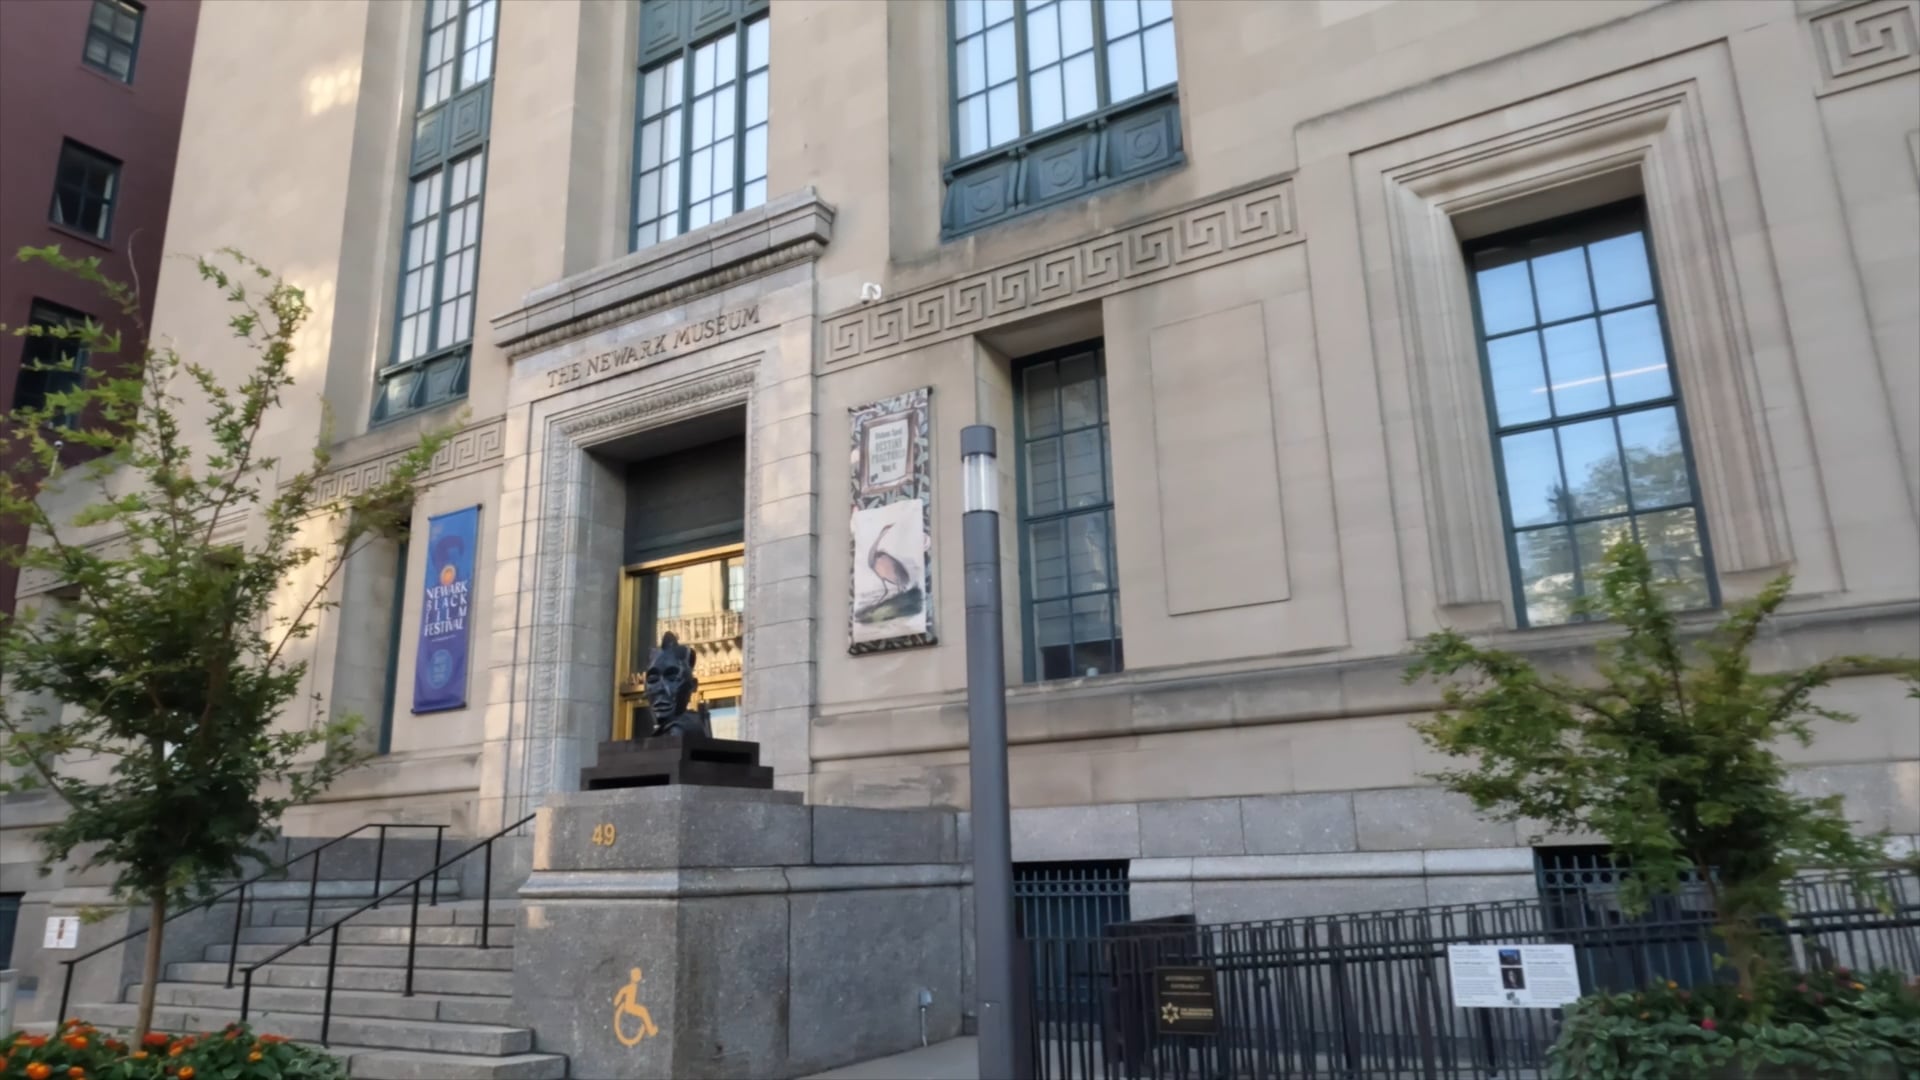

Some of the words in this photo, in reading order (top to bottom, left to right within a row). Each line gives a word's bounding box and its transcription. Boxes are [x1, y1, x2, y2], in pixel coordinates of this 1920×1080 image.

[547, 361, 581, 388] THE
[587, 334, 667, 377] NEWARK
[673, 304, 760, 350] MUSEUM
[426, 580, 468, 600] NEWARK
[426, 592, 467, 611] BLACK
[425, 605, 467, 624] FILM
[424, 617, 464, 637] FESTIVAL
[592, 823, 616, 846] 49
